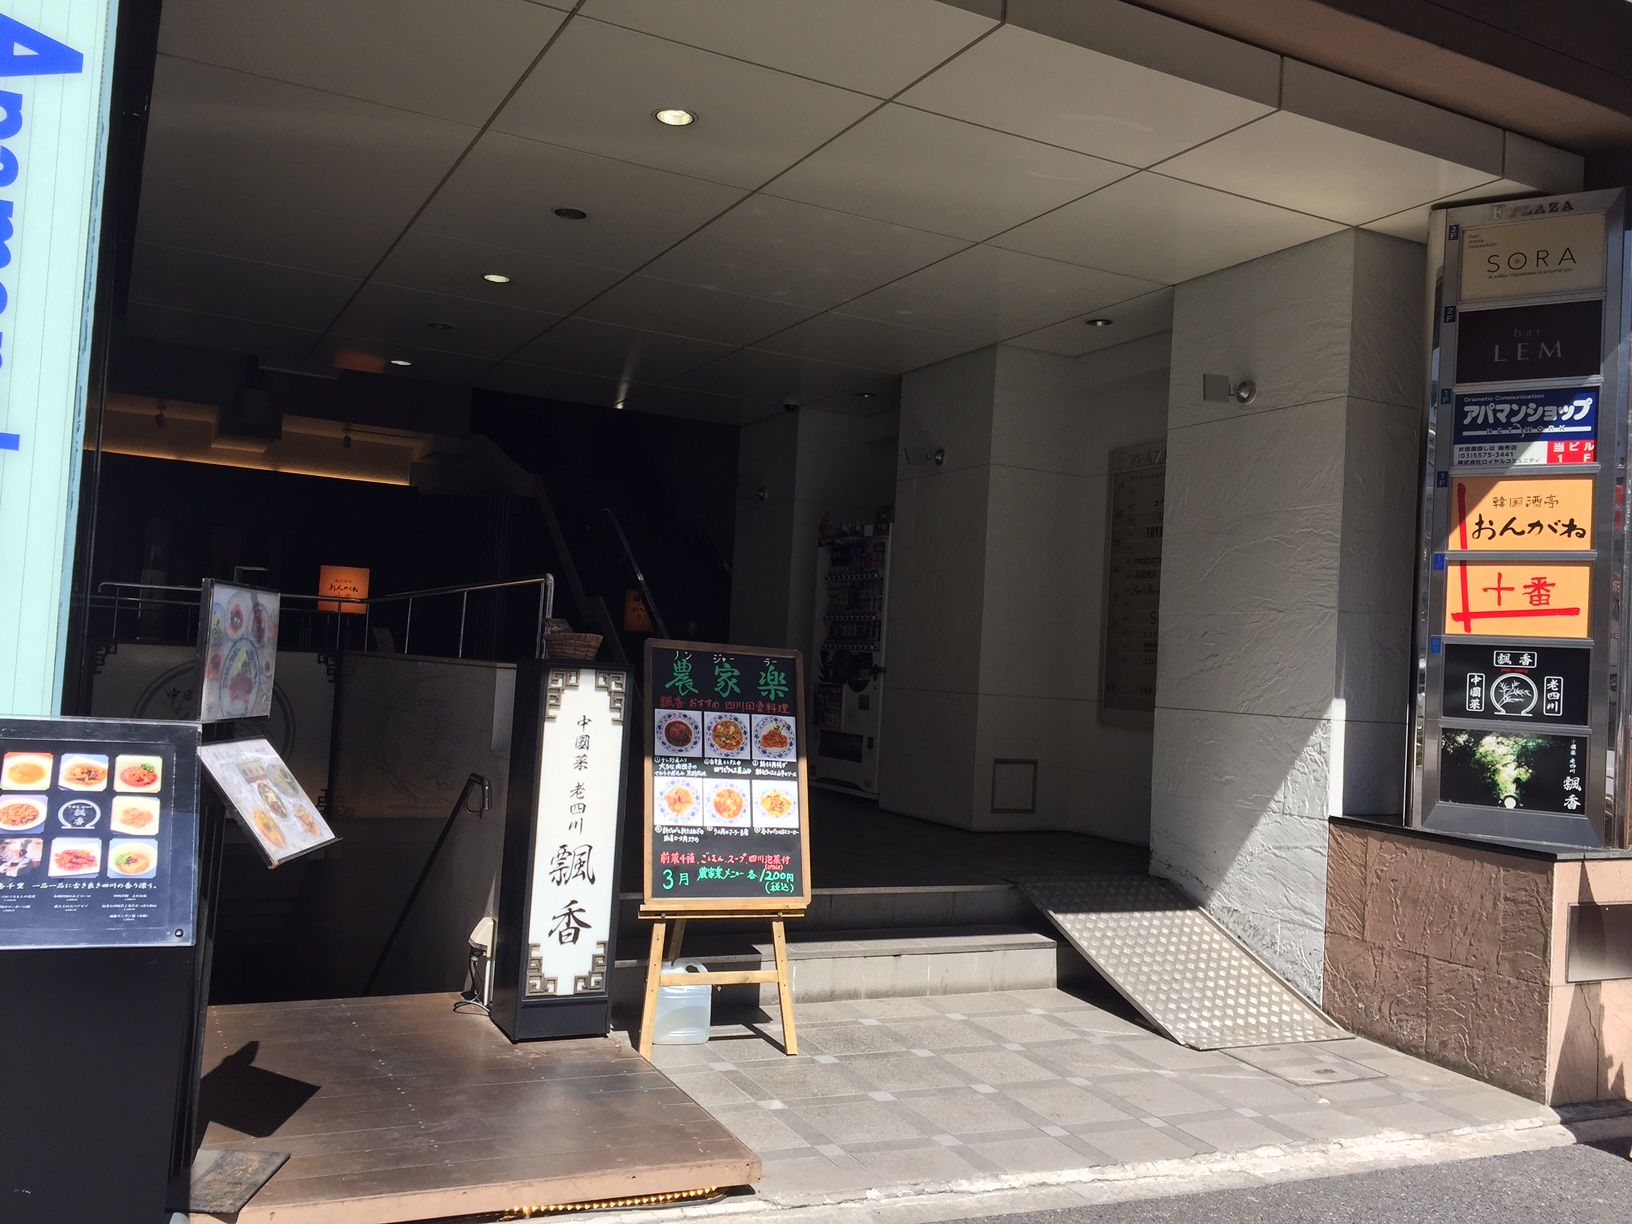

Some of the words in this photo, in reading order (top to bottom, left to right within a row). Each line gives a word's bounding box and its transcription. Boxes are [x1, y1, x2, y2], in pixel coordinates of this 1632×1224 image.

[1487, 247, 1577, 273] SORA
[1493, 341, 1562, 362] LEM
[1495, 393, 1545, 402] Communication
[1463, 397, 1593, 425] アパマンショップ
[1492, 495, 1559, 510] 韓国酒亭
[1472, 513, 1587, 541] おんがね
[1482, 572, 1556, 606] 十番
[712, 653, 735, 664] ジャー
[763, 657, 778, 667] ラー
[1546, 678, 1561, 713] 老四川
[568, 781, 586, 835] 老四川
[662, 868, 689, 890] 3月
[765, 881, 795, 895] (税込)
